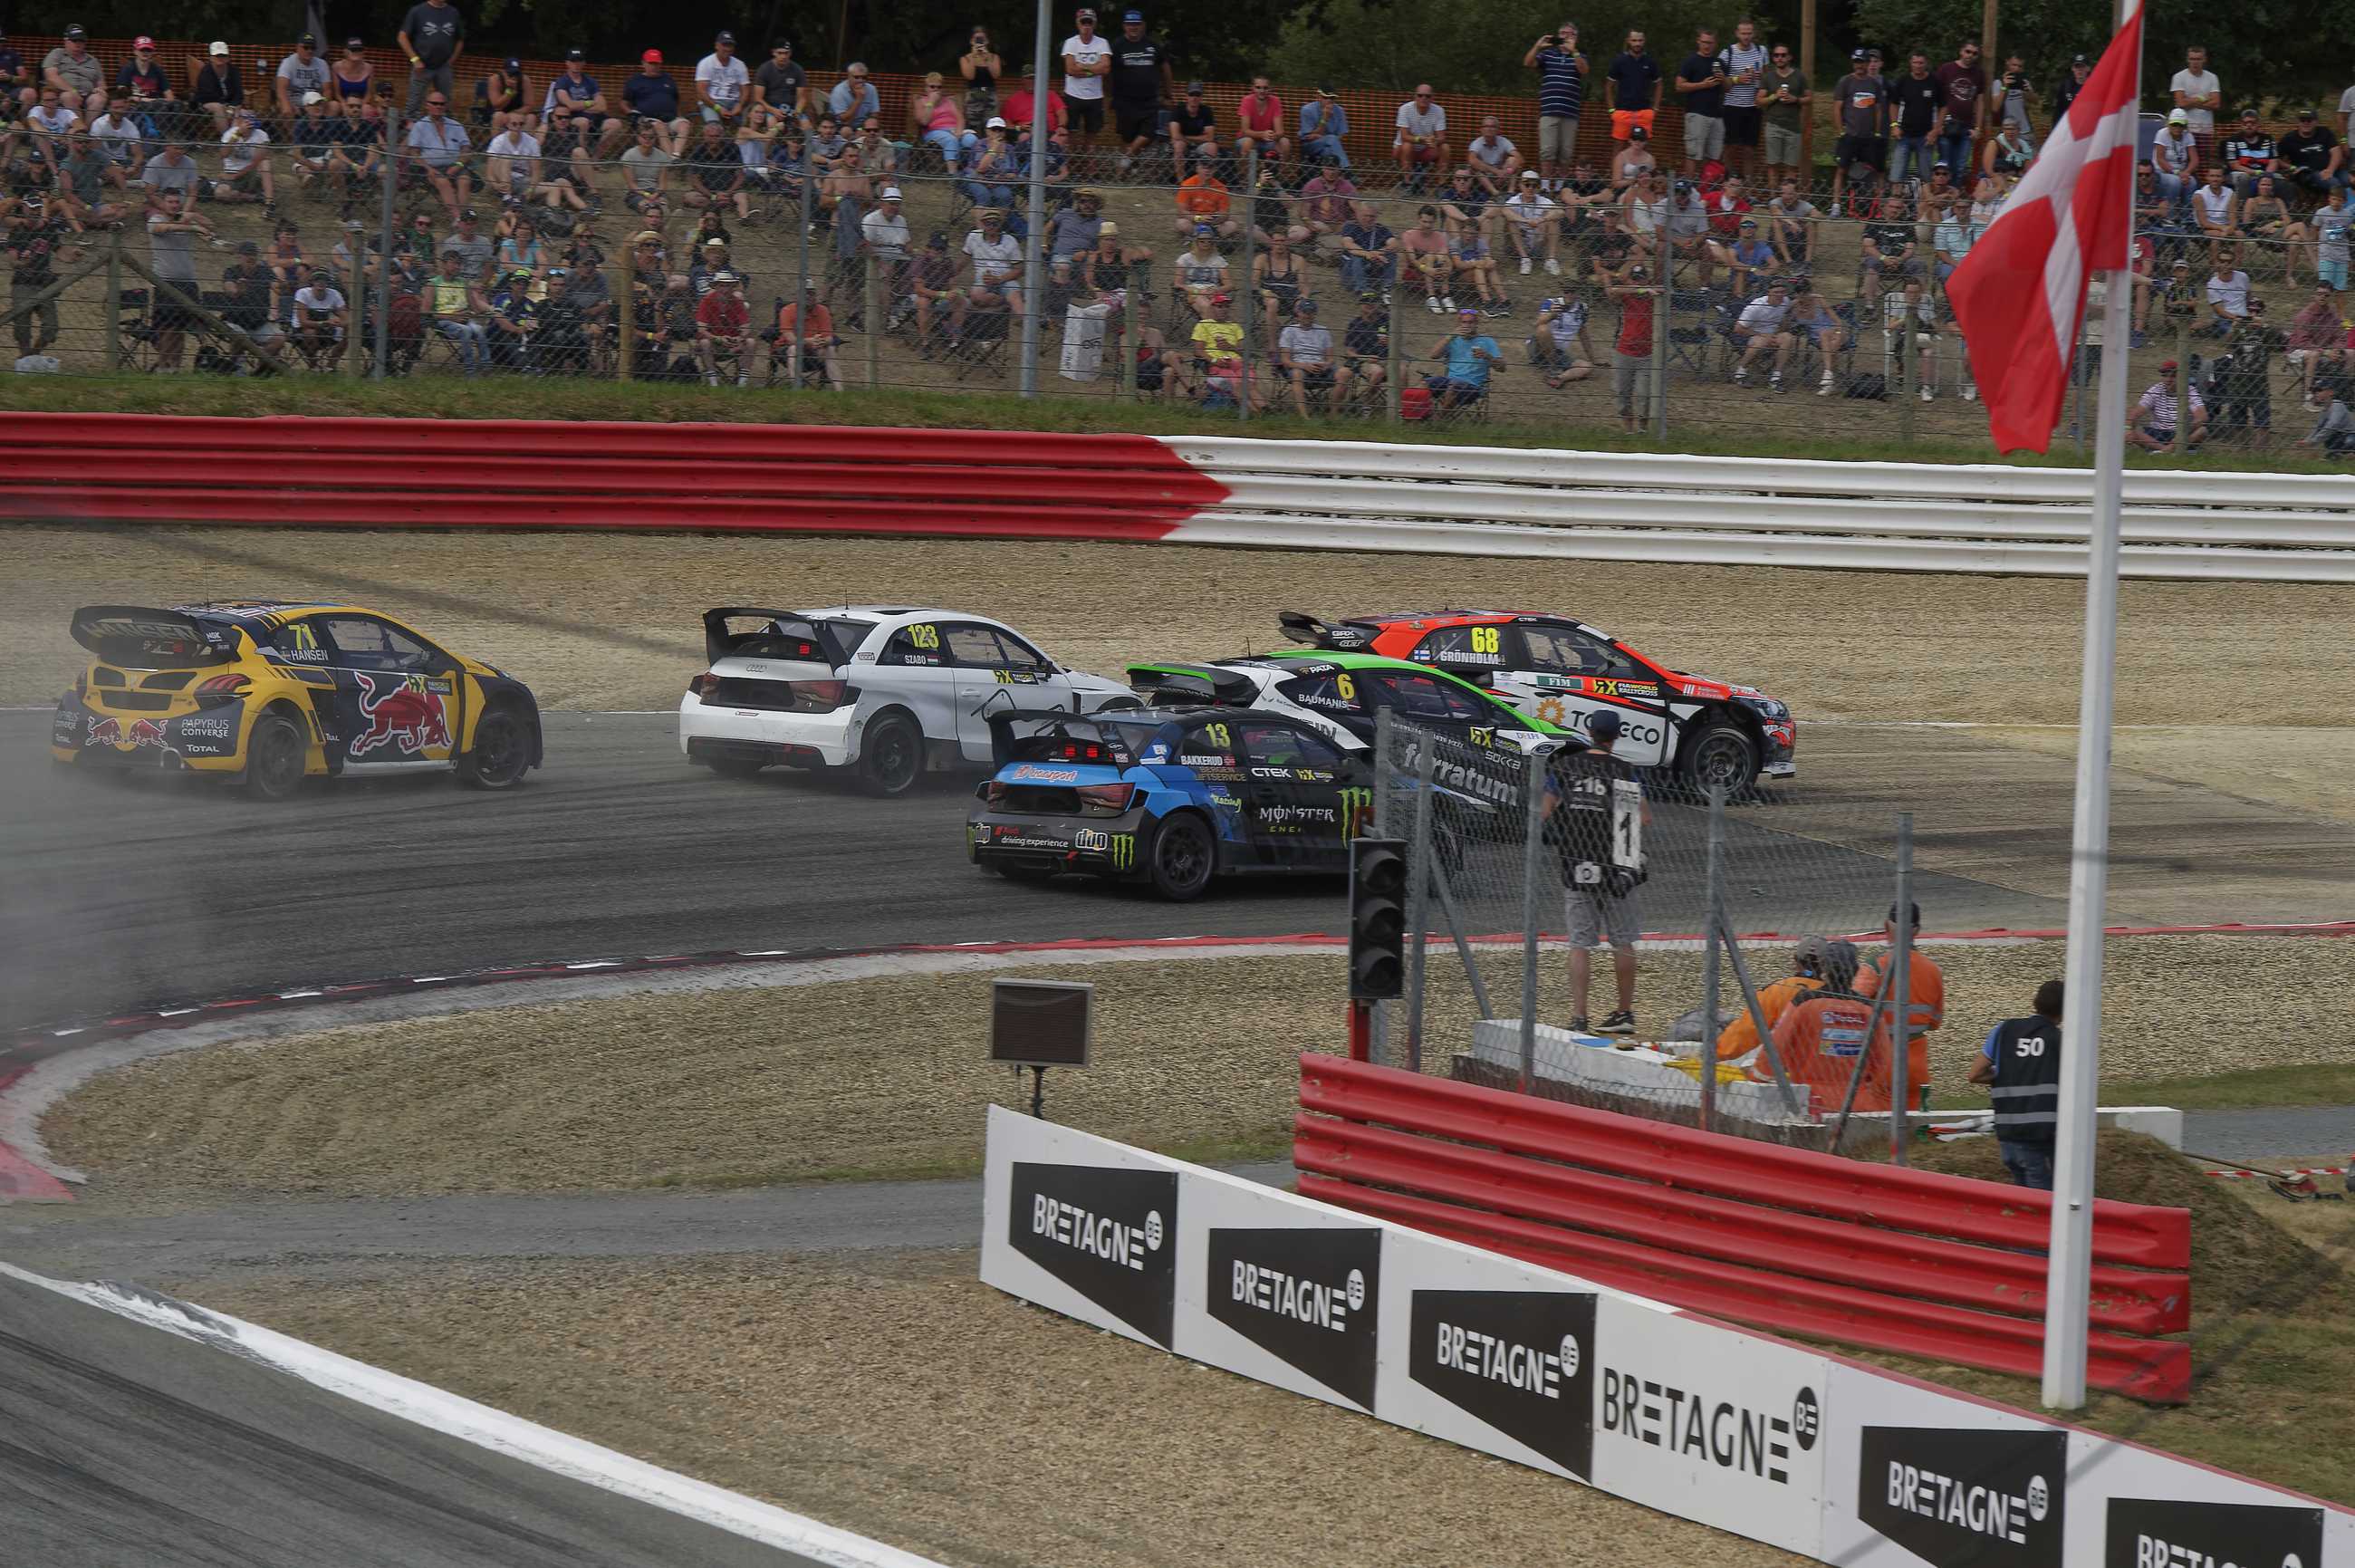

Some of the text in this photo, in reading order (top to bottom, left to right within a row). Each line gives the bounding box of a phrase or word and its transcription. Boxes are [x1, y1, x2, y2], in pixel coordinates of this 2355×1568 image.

[288, 623, 318, 649] 71
[908, 624, 940, 649] 123
[1471, 627, 1499, 653] 68
[291, 649, 329, 661] HANSEN
[905, 655, 927, 665] SZABO
[1440, 649, 1500, 665] GRÖNHOLM
[1309, 664, 1335, 673] PATA
[1337, 673, 1355, 700] 6
[1298, 694, 1349, 710] BAUMANIS
[181, 718, 232, 729] PAPYRUS
[181, 728, 229, 738] CONVERSE
[1205, 723, 1231, 748] 13
[1180, 755, 1223, 766] BAKKERUD
[1251, 767, 1293, 778] CTEK
[1259, 804, 1335, 823] MONSTER
[1026, 838, 1070, 849] experience
[2015, 1037, 2045, 1058] 50
[1033, 1193, 1145, 1271] BRETAGNE
[1232, 1259, 1347, 1332] BRETAGNE
[1437, 1322, 1560, 1400] BRETAGNE
[1603, 1367, 1790, 1485] BRETAGNE
[1888, 1460, 2027, 1544] BRETAGNE
